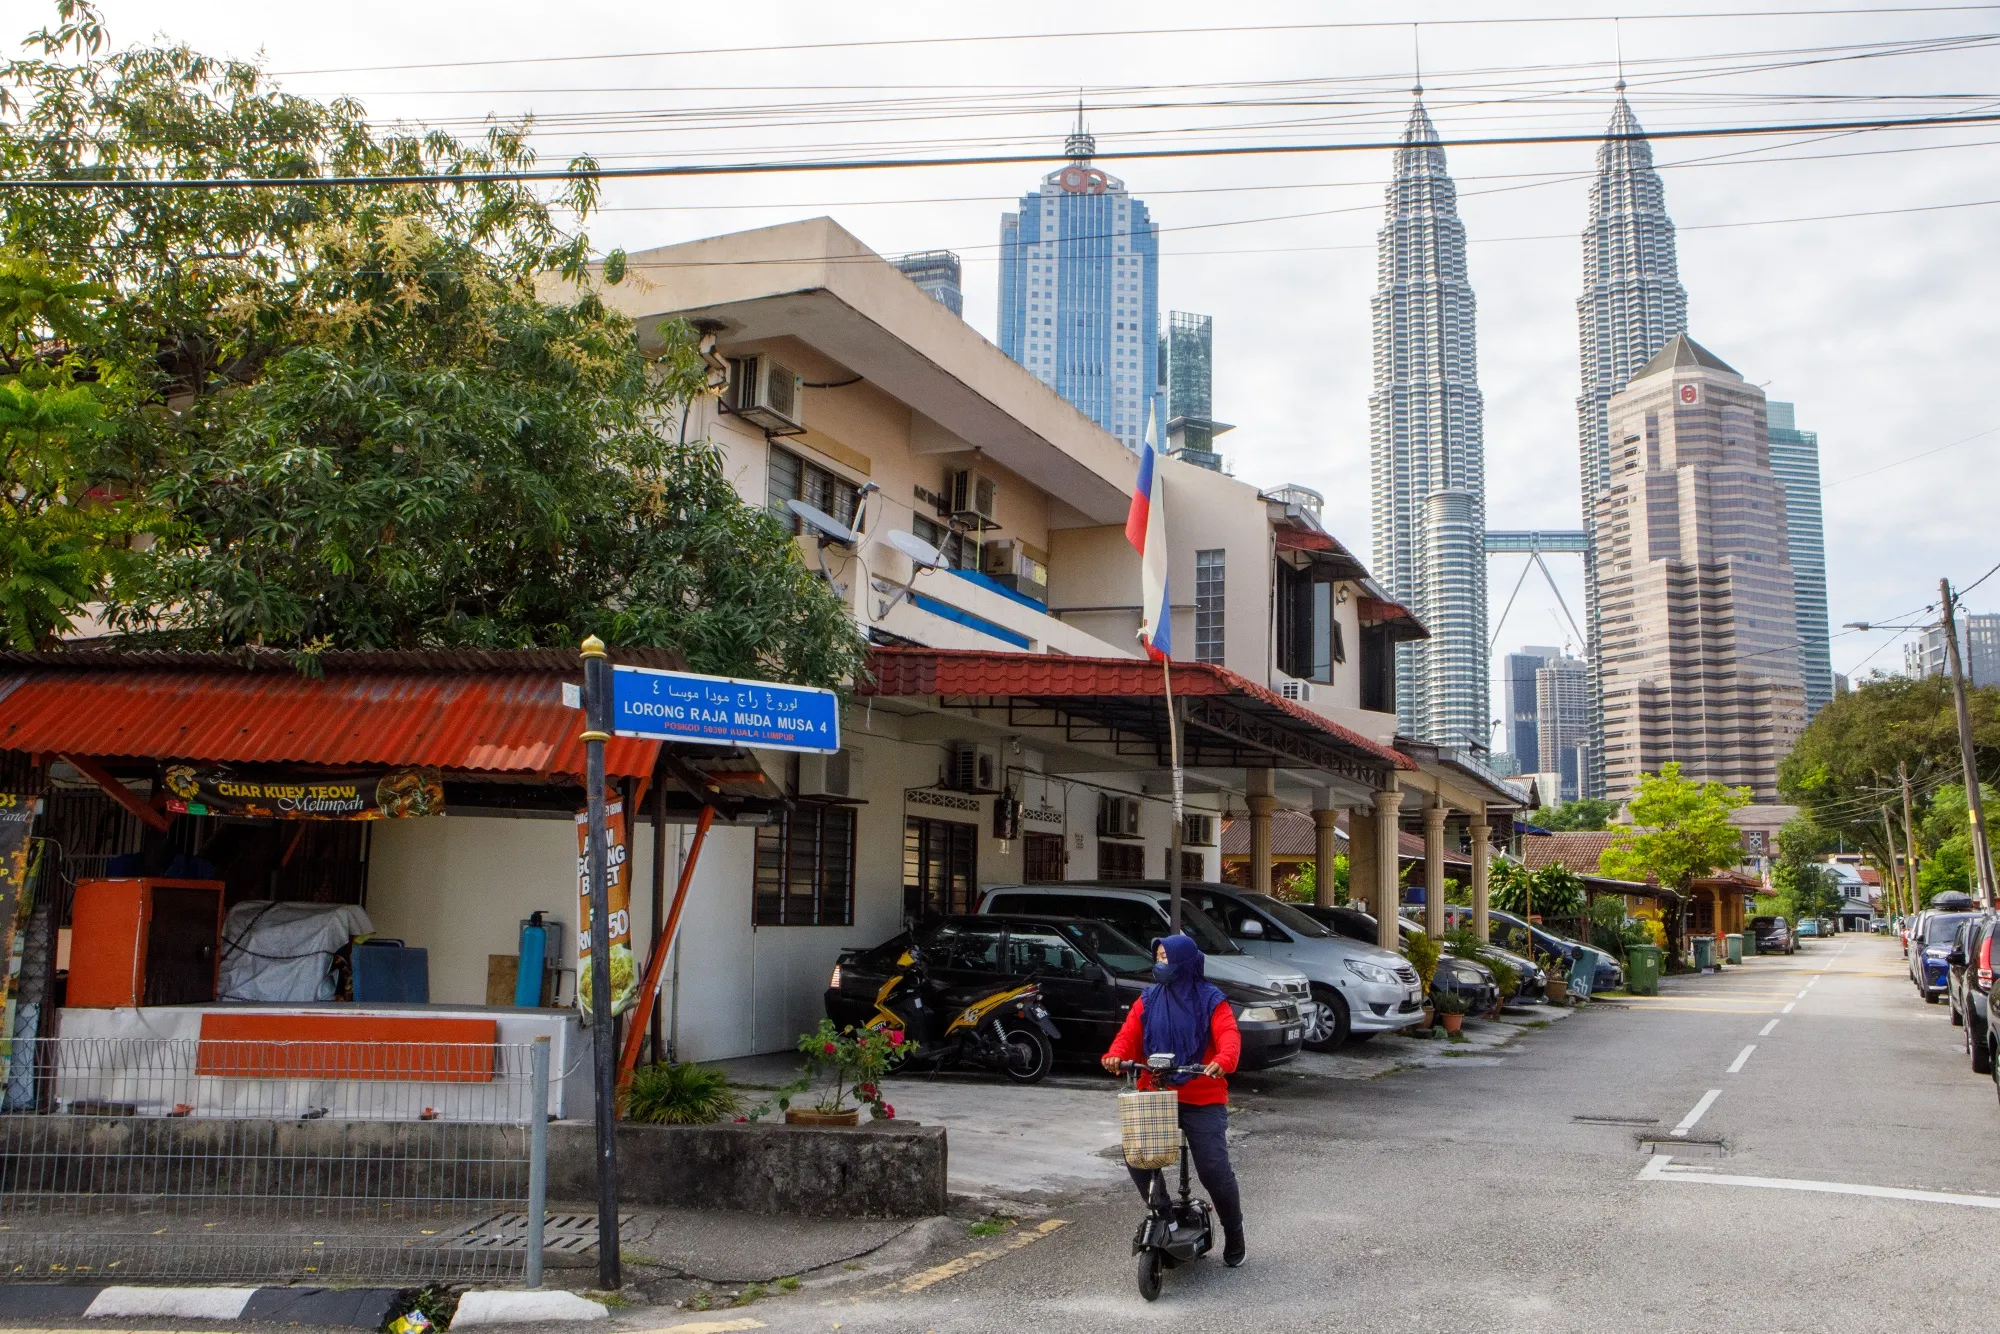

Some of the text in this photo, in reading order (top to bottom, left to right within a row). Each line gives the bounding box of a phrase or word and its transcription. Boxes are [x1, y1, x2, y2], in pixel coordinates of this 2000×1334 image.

[668, 685, 699, 702] موسا
[705, 686, 730, 705] مودا
[624, 701, 827, 733] LORONG RAJA MUDA MUSA 4
[664, 721, 794, 741] POSKOD 50300 KUALA LUMPUR
[218, 783, 356, 799] CHAR KUEY TEOW
[277, 795, 364, 815] Melimpah
